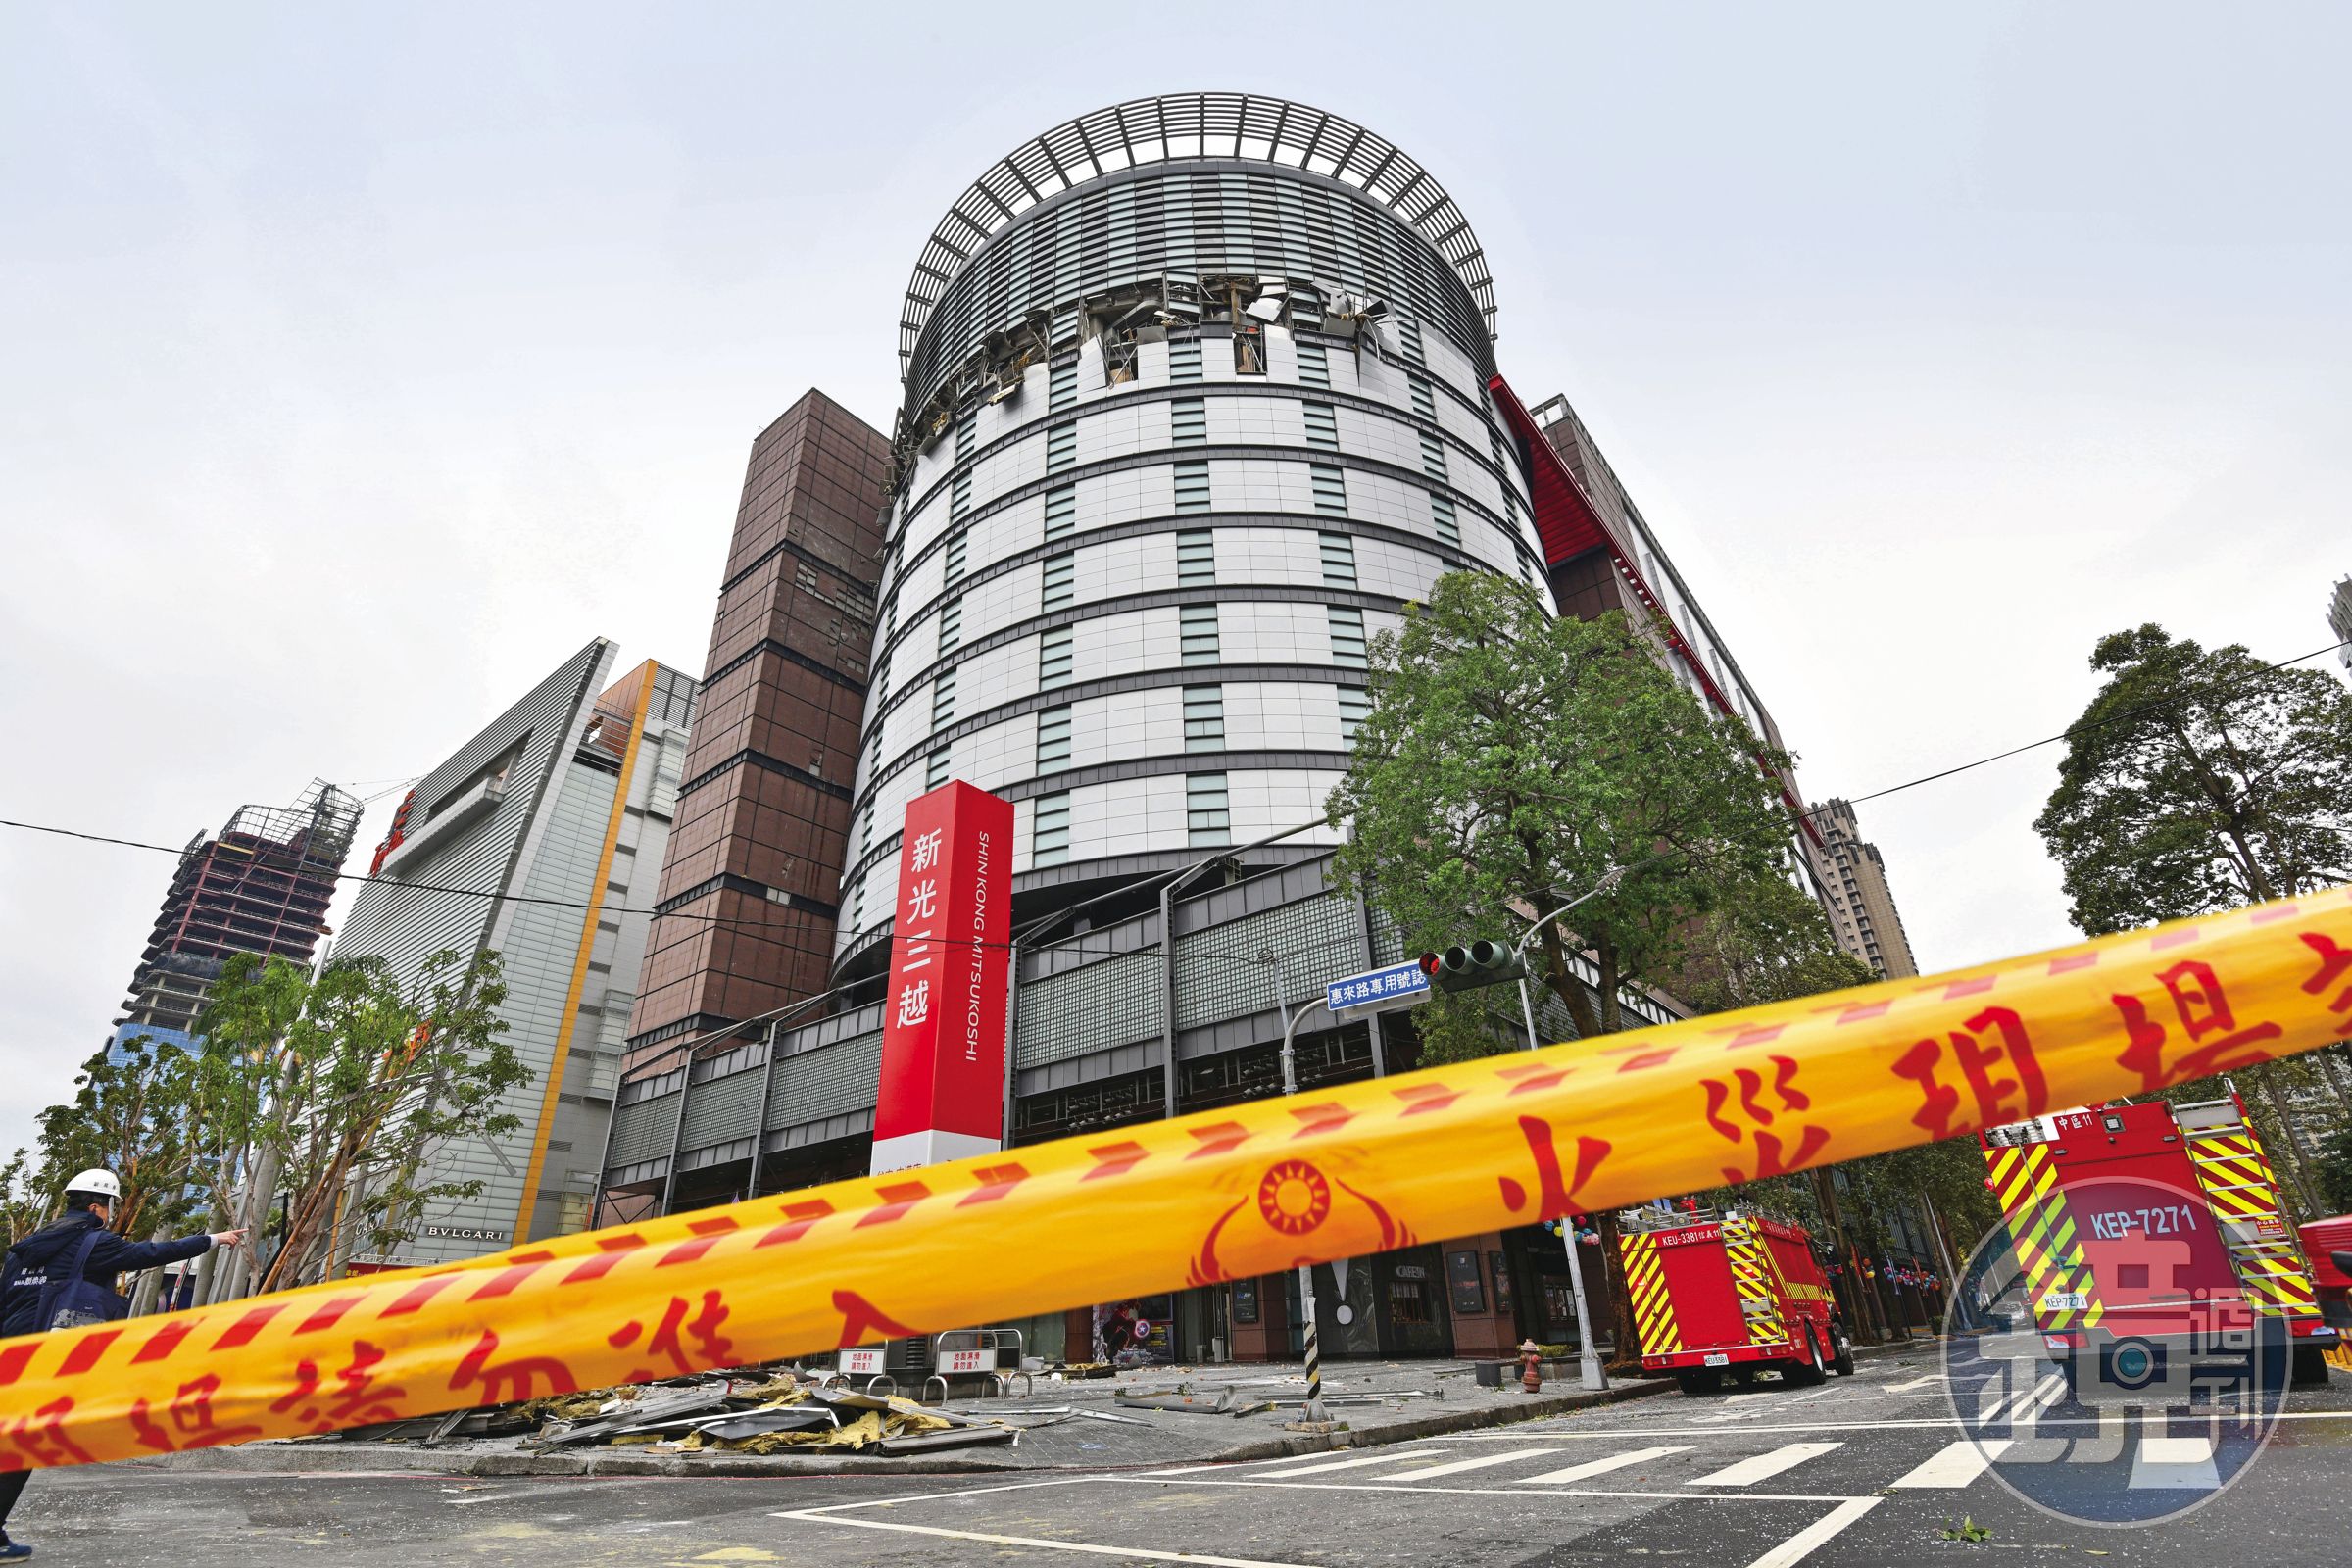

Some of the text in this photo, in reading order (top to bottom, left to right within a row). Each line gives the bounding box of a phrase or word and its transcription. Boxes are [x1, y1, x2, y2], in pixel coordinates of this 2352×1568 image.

[897, 827, 942, 1029] 新光三越
[965, 830, 990, 1061] SHIN KONG MITSUKOSHI
[1330, 969, 1427, 1004] 惠來路專用號誌
[2058, 1113, 2093, 1131] 中區11
[427, 1226, 503, 1240] BVLGARI
[2089, 1204, 2197, 1240] KEP-7271
[1661, 1231, 1699, 1246] KEU-3381
[2044, 1295, 2085, 1308] KEP-7271
